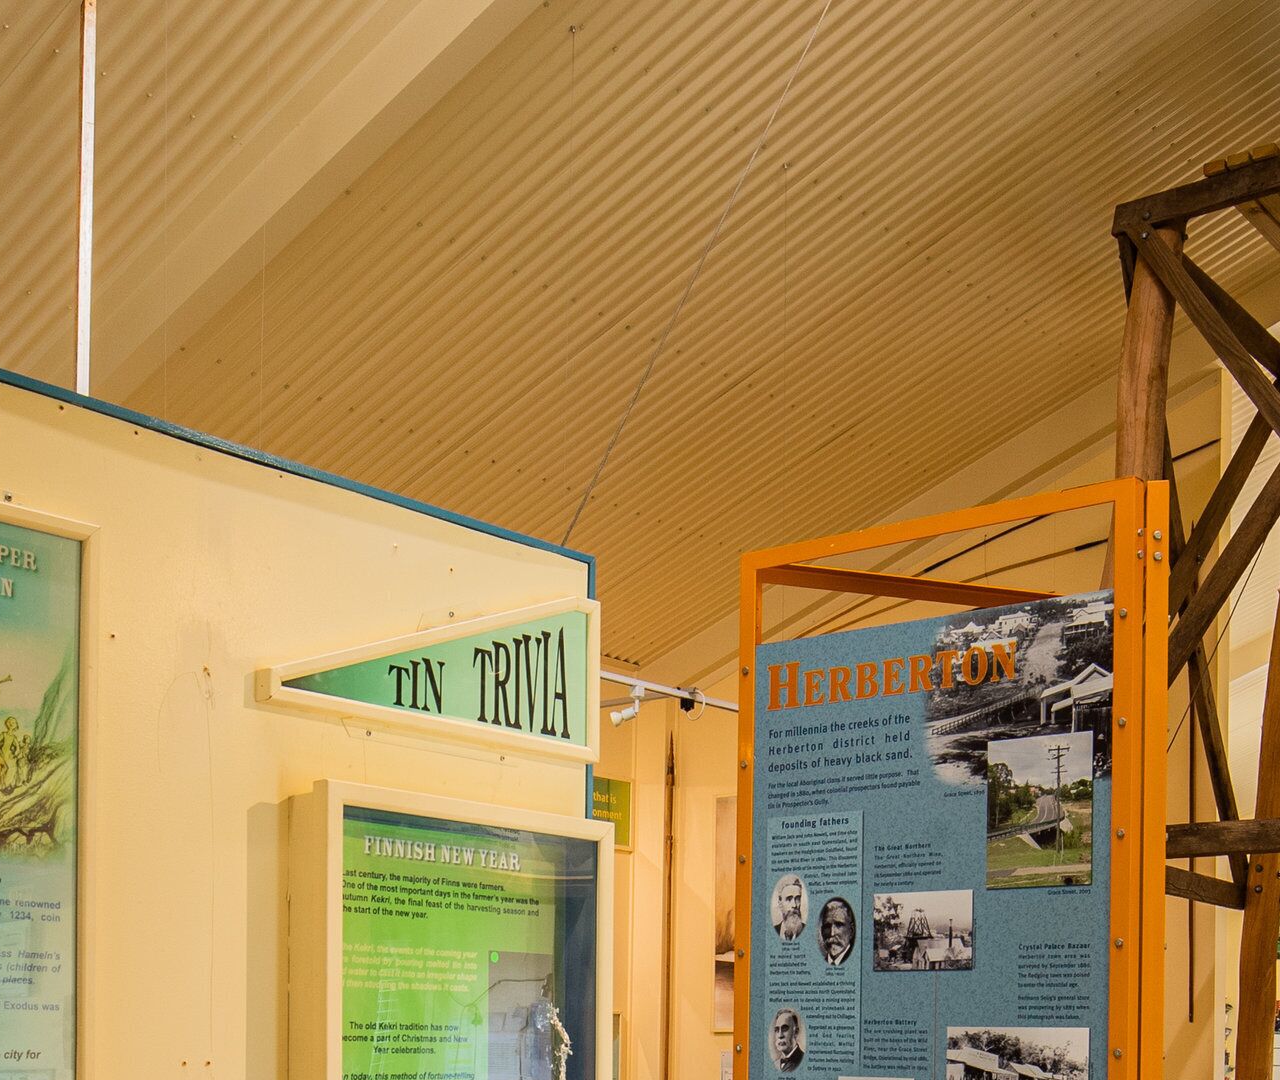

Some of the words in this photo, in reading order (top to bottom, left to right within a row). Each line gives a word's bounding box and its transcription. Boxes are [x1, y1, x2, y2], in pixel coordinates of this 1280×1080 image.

[388, 657, 446, 714] TIN
[472, 626, 571, 739] TRIVIA
[769, 728, 782, 739] For
[785, 722, 827, 737] millennia
[830, 720, 845, 732] the
[848, 717, 879, 730] creeks
[882, 714, 892, 726] of
[894, 713, 910, 725] the
[769, 740, 823, 755] Herberton
[833, 733, 874, 748] district
[885, 729, 909, 743] held
[768, 758, 809, 774] deposits
[811, 756, 821, 768] of
[824, 755, 851, 767] heavy
[855, 750, 882, 763] black
[885, 747, 912, 760] sand.
[593, 791, 609, 803] that
[610, 793, 617, 804] is
[781, 818, 816, 829] founding
[820, 816, 849, 826] fathers
[364, 835, 435, 862] FINNISH
[440, 843, 474, 866] NEW
[479, 847, 520, 871] YEAR
[359, 869, 387, 882] century,
[389, 871, 400, 881] the
[402, 873, 430, 887] majority
[432, 876, 440, 885] of
[441, 876, 460, 887] Finns
[479, 880, 505, 892] farmers.
[4, 1048, 22, 1062] city
[26, 1048, 41, 1059] for
